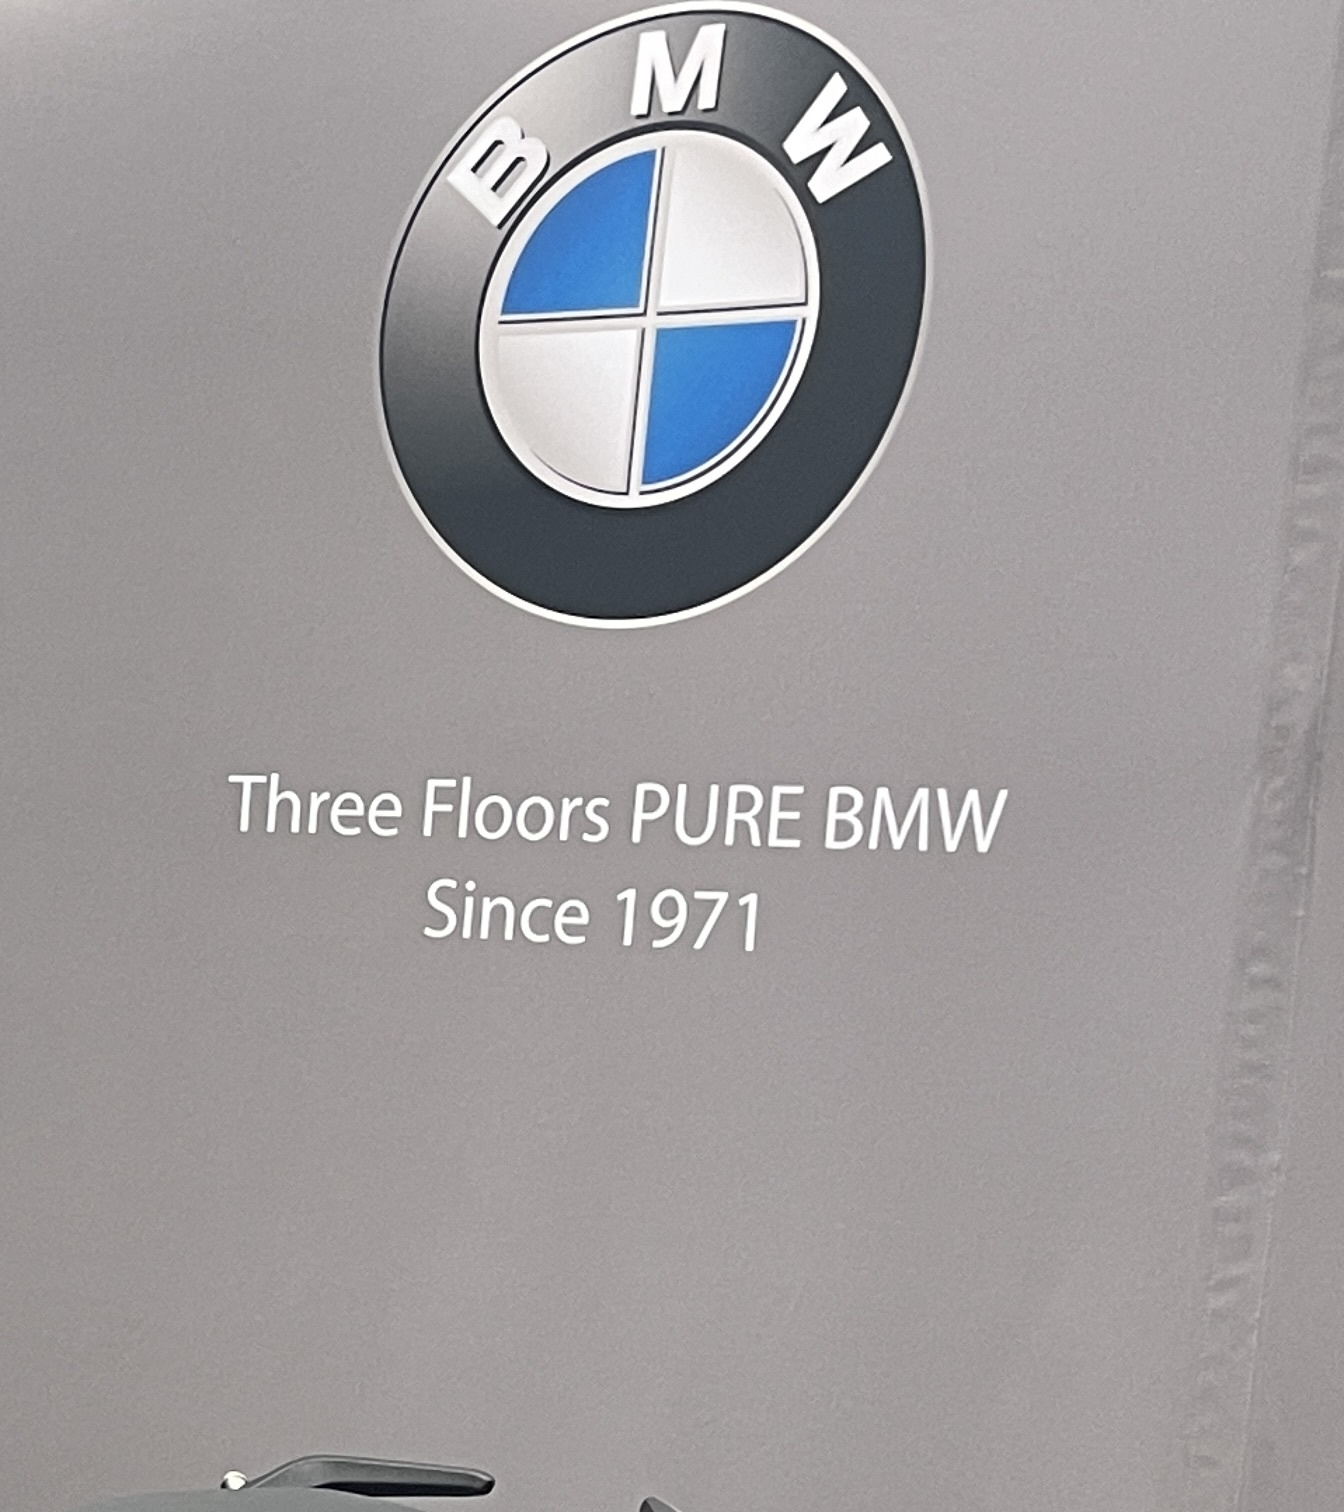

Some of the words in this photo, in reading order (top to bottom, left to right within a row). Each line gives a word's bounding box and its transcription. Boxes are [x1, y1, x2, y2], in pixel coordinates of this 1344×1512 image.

[446, 23, 893, 227] BMW
[228, 772, 404, 838] Three
[422, 776, 611, 844] Floors
[630, 782, 805, 849] PURE
[824, 786, 1009, 854] BMW
[422, 878, 591, 946] Since
[615, 888, 760, 953] 1971
